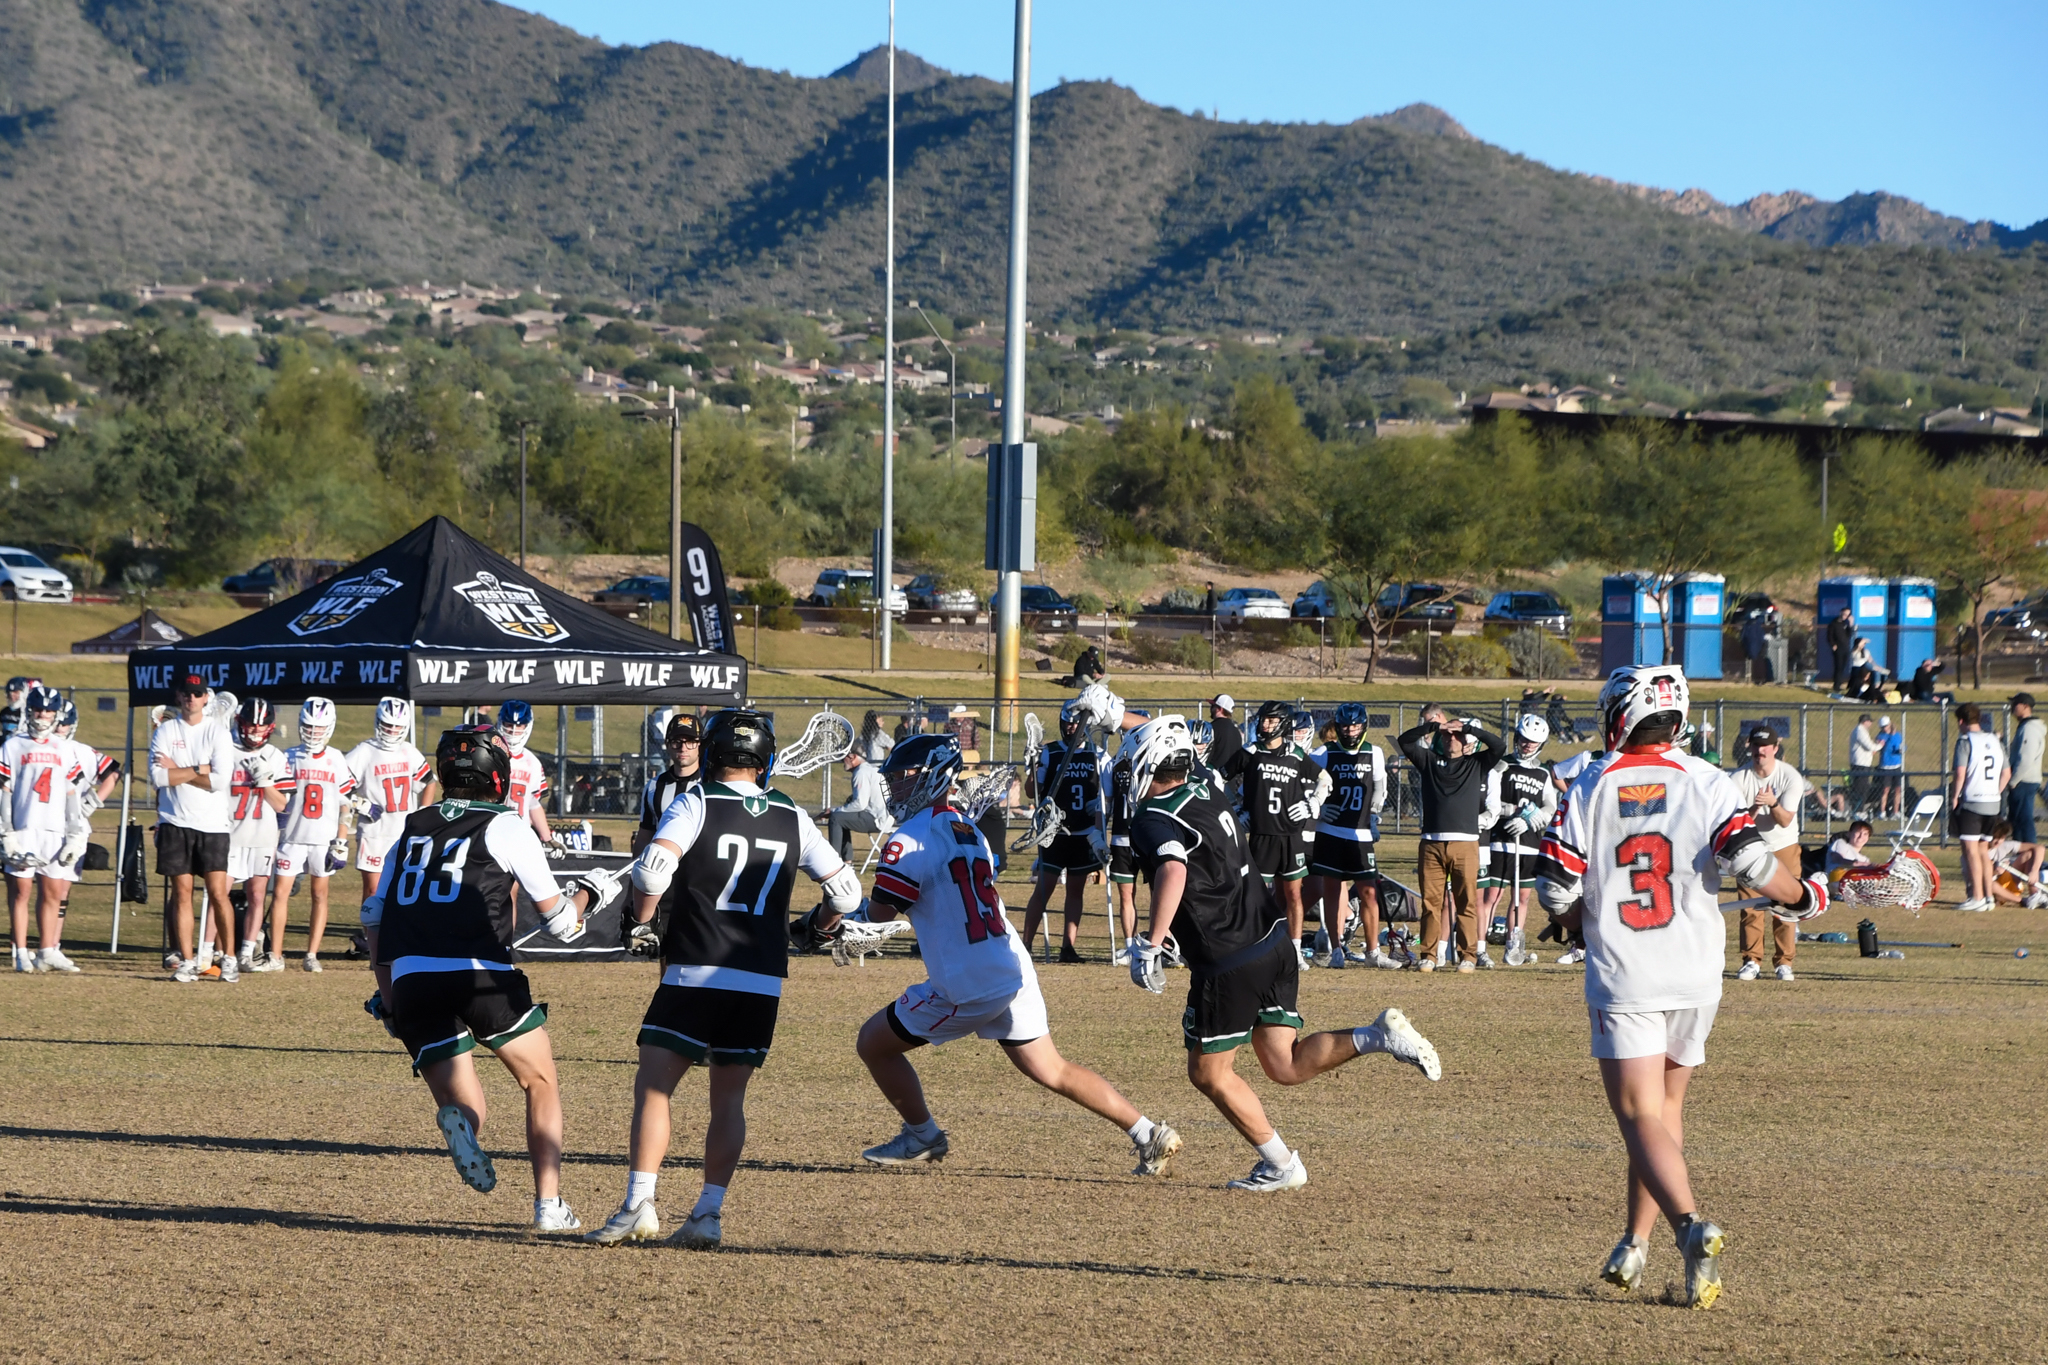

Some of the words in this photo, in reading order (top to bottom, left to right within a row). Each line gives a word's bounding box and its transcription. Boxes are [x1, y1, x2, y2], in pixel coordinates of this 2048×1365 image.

[687, 547, 711, 596] 9
[331, 585, 389, 594] WESTERN
[467, 590, 533, 601] WESTERN
[307, 597, 378, 614] WLF
[474, 603, 551, 623] WLF
[134, 665, 174, 689] WLF
[244, 662, 286, 686] WLF
[301, 661, 344, 684] WLF
[358, 660, 402, 683] WLF
[416, 659, 470, 684] WLF
[486, 659, 537, 684] WLF
[554, 660, 604, 685] WLF
[622, 662, 673, 686] WLF
[690, 664, 740, 690] WLF
[295, 769, 336, 784] ARIZONA
[373, 762, 409, 777] ARIZON
[1056, 762, 1095, 772] DVNC
[1257, 763, 1298, 778] ADVNC
[1262, 772, 1290, 783] PNW
[1332, 763, 1372, 772] ADVNC
[1984, 756, 1994, 780] 2
[33, 767, 52, 803] 4
[1509, 774, 1544, 790] ADVNC
[1515, 782, 1539, 795] PNW
[231, 785, 265, 820] 77
[303, 783, 323, 819] 8
[382, 776, 410, 813] 17
[1071, 785, 1084, 810] 3
[1268, 787, 1282, 814] 5
[1340, 785, 1363, 811] 28
[397, 836, 471, 906] 83
[715, 834, 788, 915] 27
[1615, 831, 1676, 932] 3
